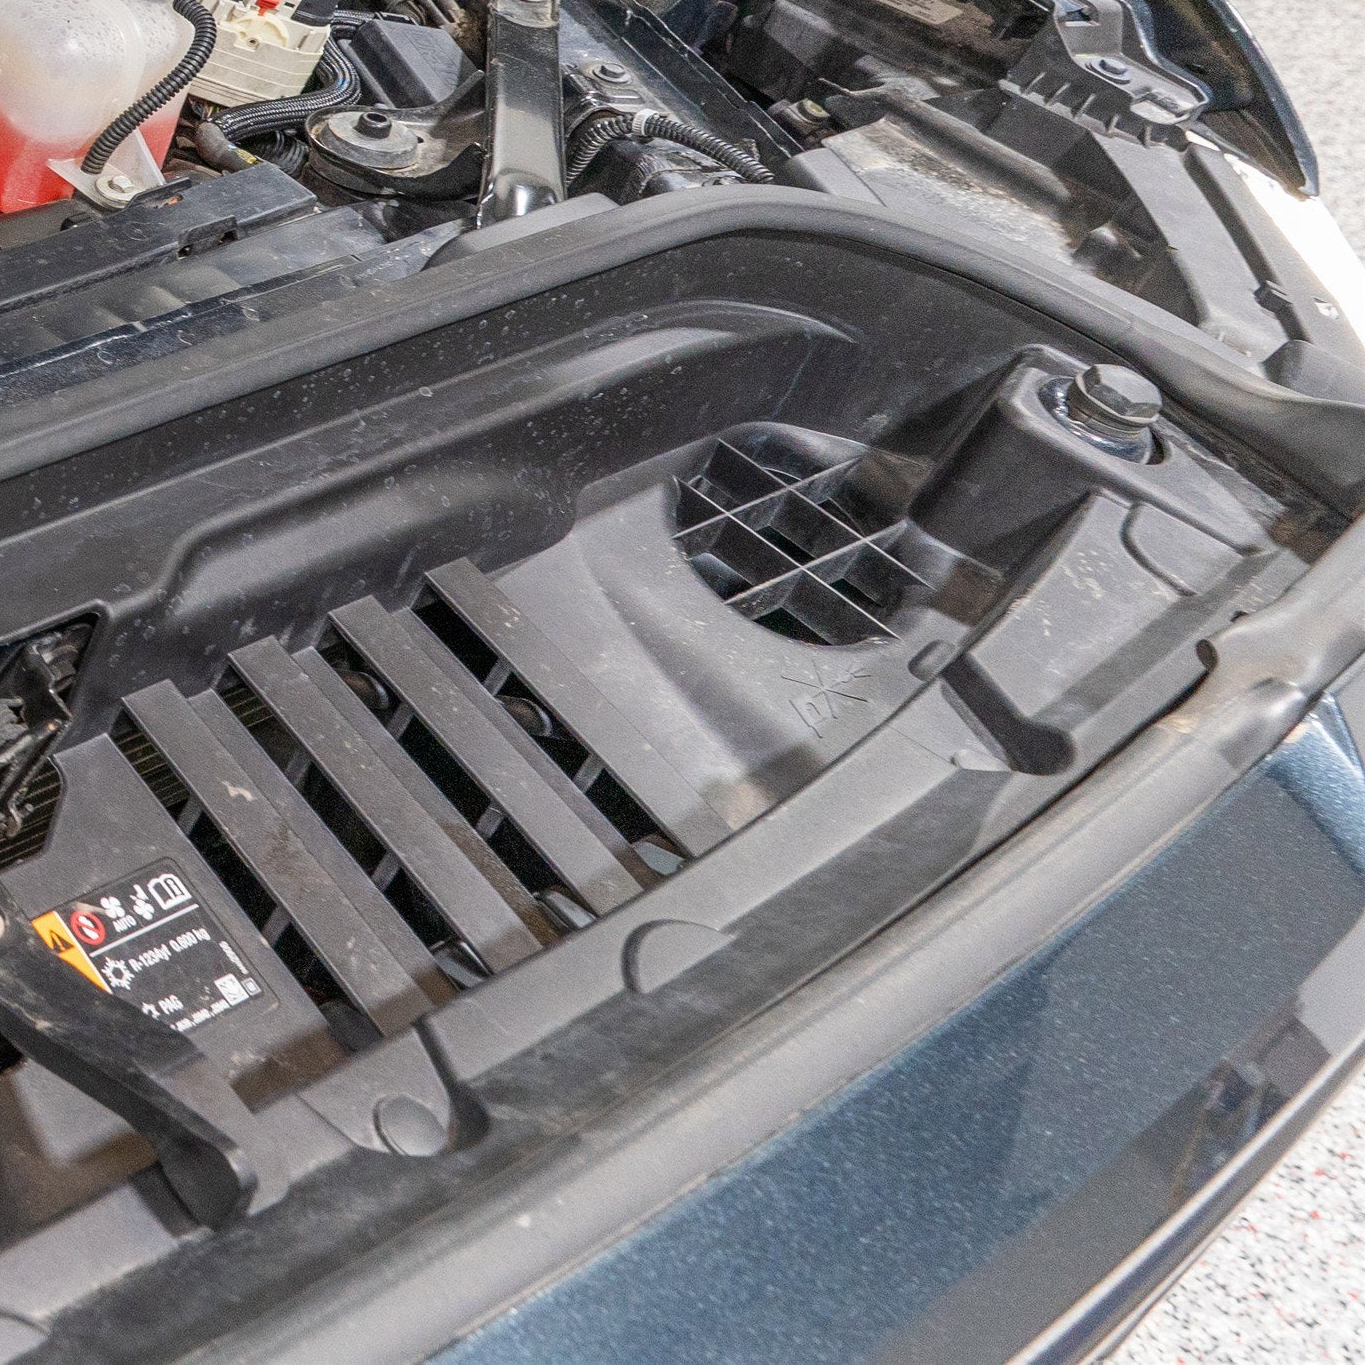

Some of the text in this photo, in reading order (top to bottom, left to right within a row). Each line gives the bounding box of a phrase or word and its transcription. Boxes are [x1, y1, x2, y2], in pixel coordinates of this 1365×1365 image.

[113, 915, 136, 932] AUTO
[128, 927, 212, 973] R-1234yf 0.600 kg
[158, 994, 185, 1015] PAG
